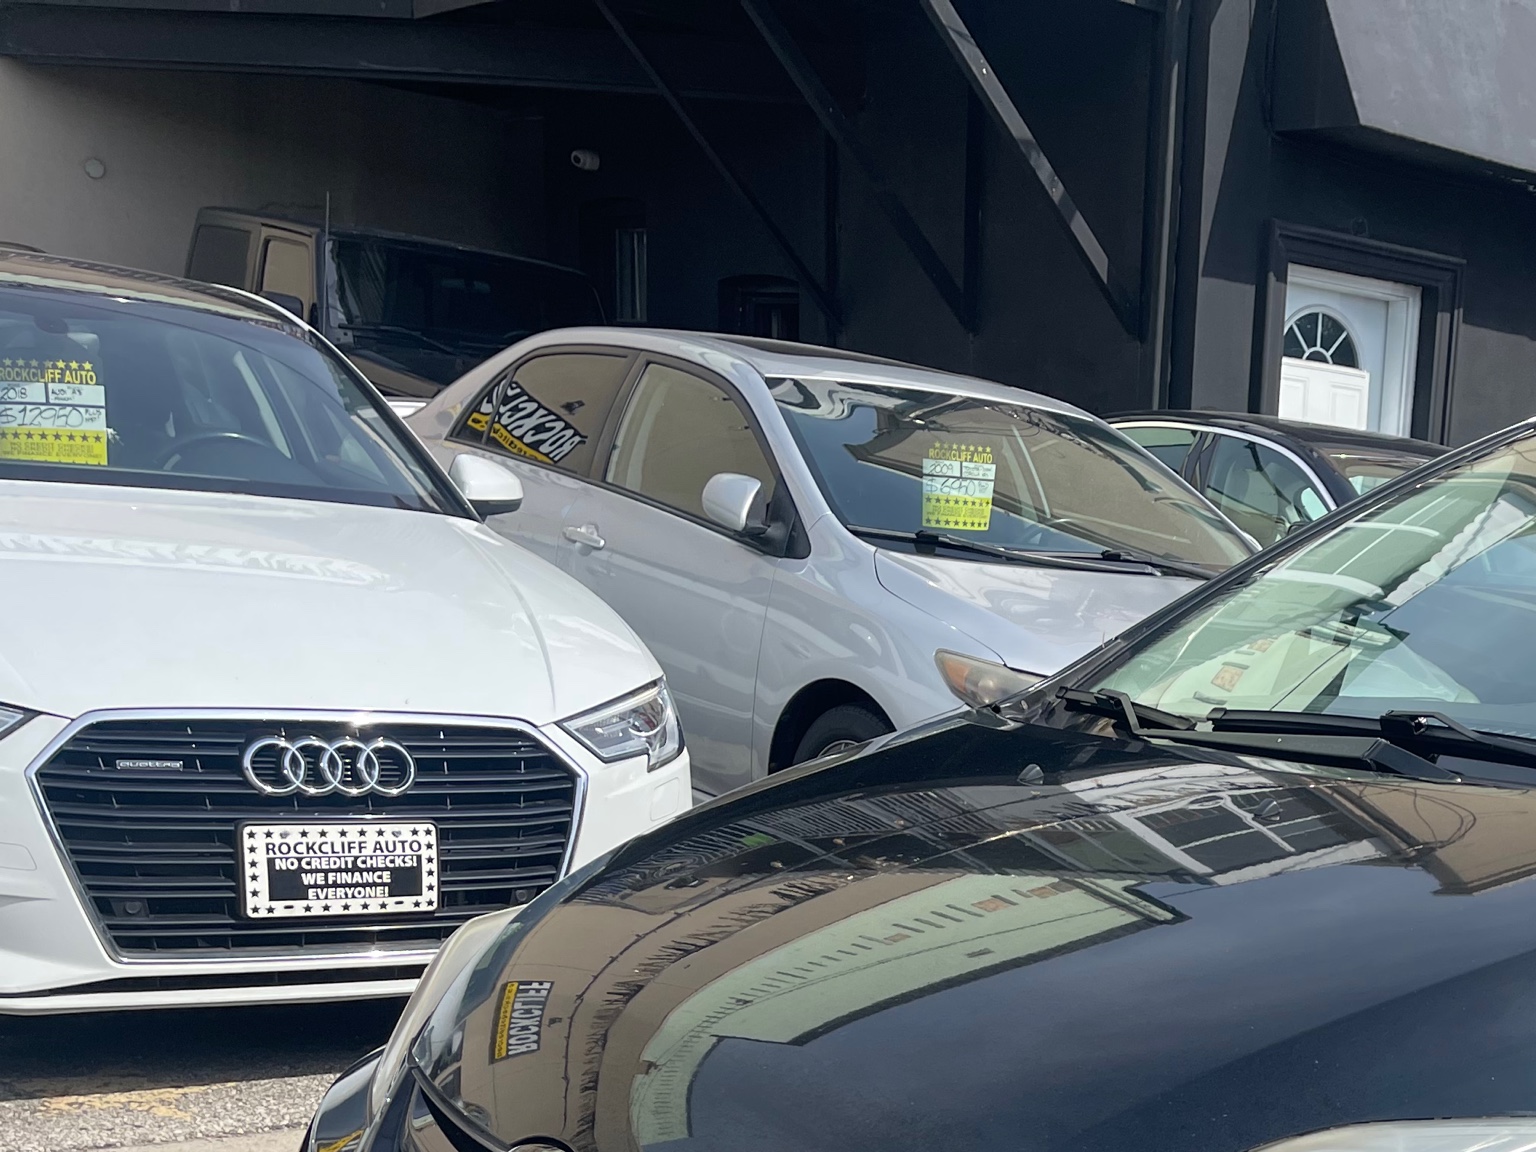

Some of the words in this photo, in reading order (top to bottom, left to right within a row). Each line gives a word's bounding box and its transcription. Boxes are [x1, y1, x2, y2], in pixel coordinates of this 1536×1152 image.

[65, 370, 97, 385] AUTO
[0, 387, 28, 401] 2018
[929, 449, 971, 462] ROCKCLIFF
[973, 453, 993, 464] AUTO
[928, 463, 953, 474] 2009
[119, 761, 181, 769] quattro
[265, 841, 367, 855] ROCKCLIFF
[373, 840, 422, 853] AUTO
[275, 858, 299, 870] NO
[301, 856, 354, 869] CREDIT
[357, 855, 417, 868] CHECKS!
[301, 873, 325, 885] WE
[328, 871, 391, 884] FINANCE
[308, 886, 389, 900] EVERYONE!
